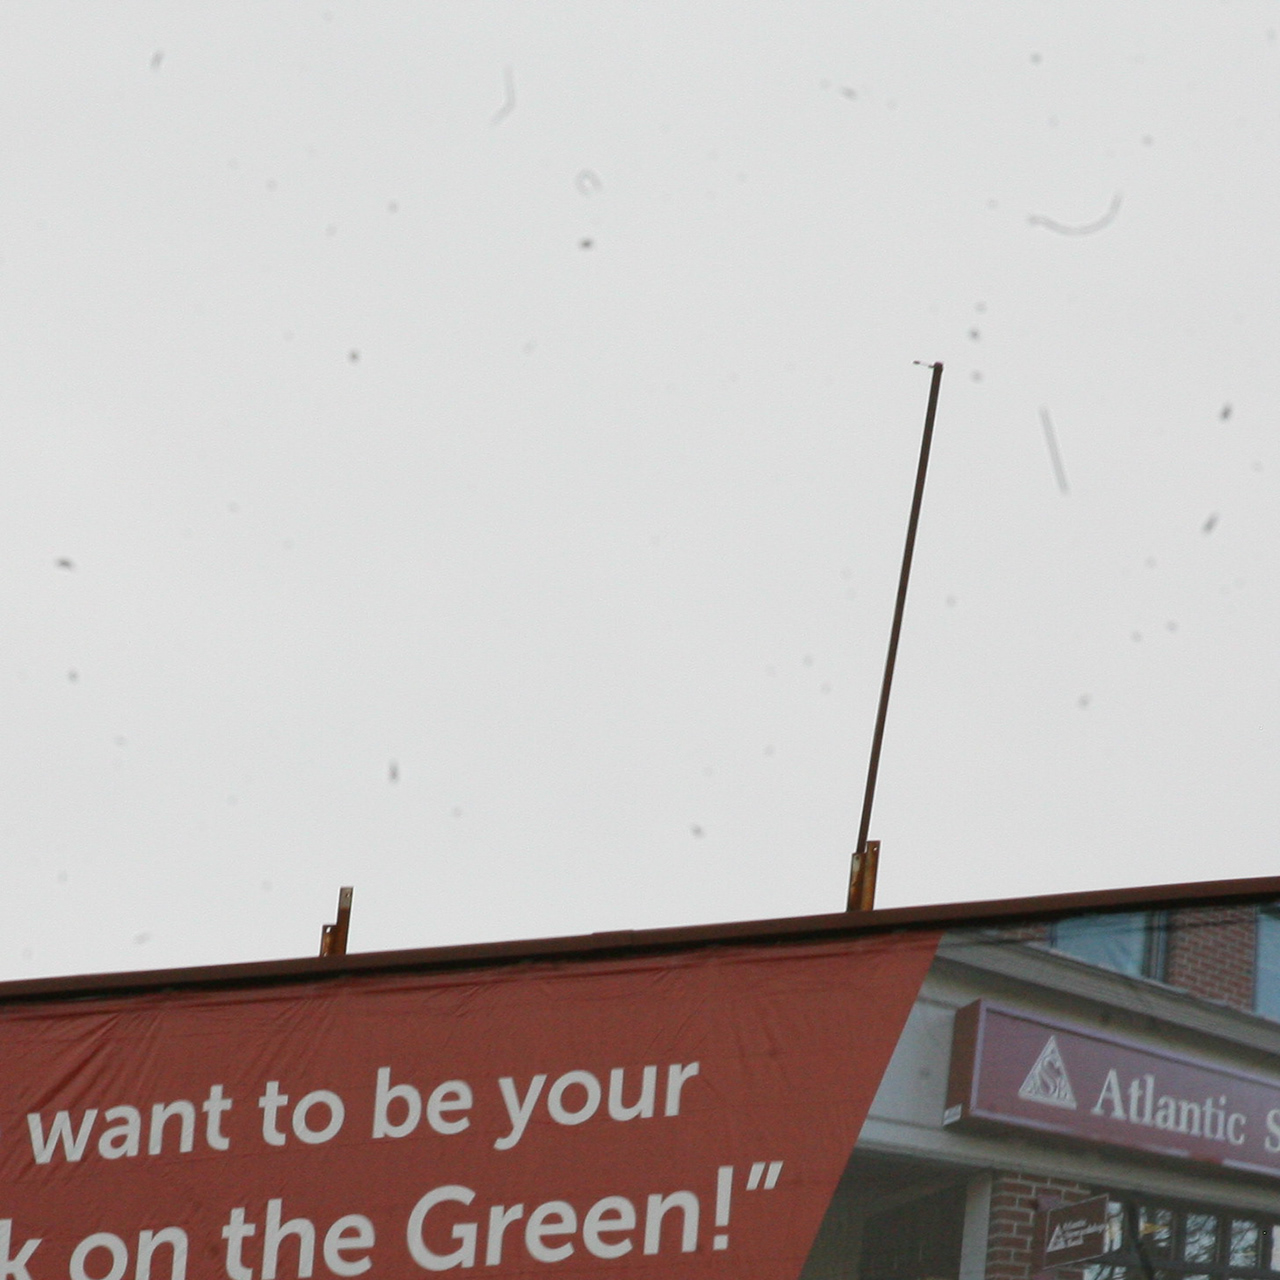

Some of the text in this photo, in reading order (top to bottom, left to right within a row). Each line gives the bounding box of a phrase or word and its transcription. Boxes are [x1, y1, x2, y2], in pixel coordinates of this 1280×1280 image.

[27, 1084, 232, 1164] want
[257, 1079, 344, 1146] to
[371, 1066, 473, 1139] be
[494, 1059, 699, 1150] your
[1091, 1068, 1246, 1147] Atlantic
[406, 1160, 784, 1272] Green!”
